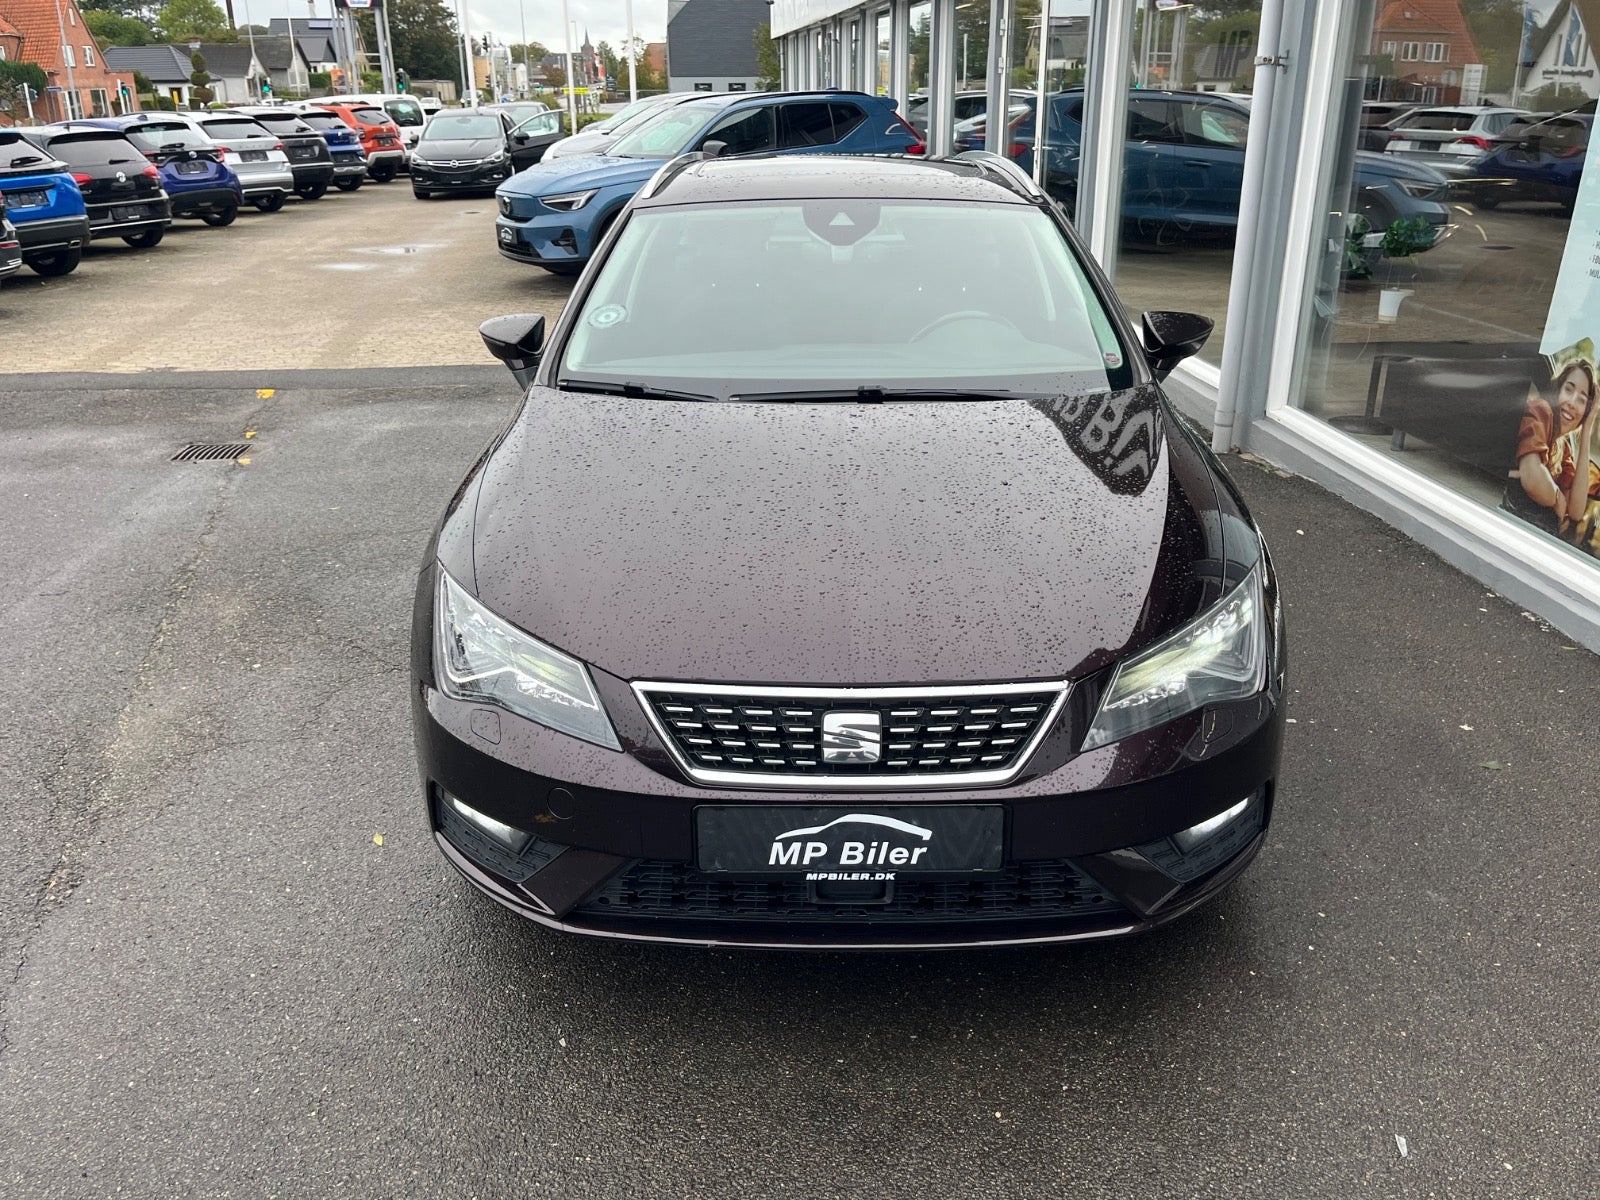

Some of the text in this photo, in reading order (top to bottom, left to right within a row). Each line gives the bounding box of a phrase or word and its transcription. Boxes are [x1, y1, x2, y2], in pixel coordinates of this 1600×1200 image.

[768, 841, 928, 865] MP Biler
[805, 872, 896, 881] MPBILER.DK
